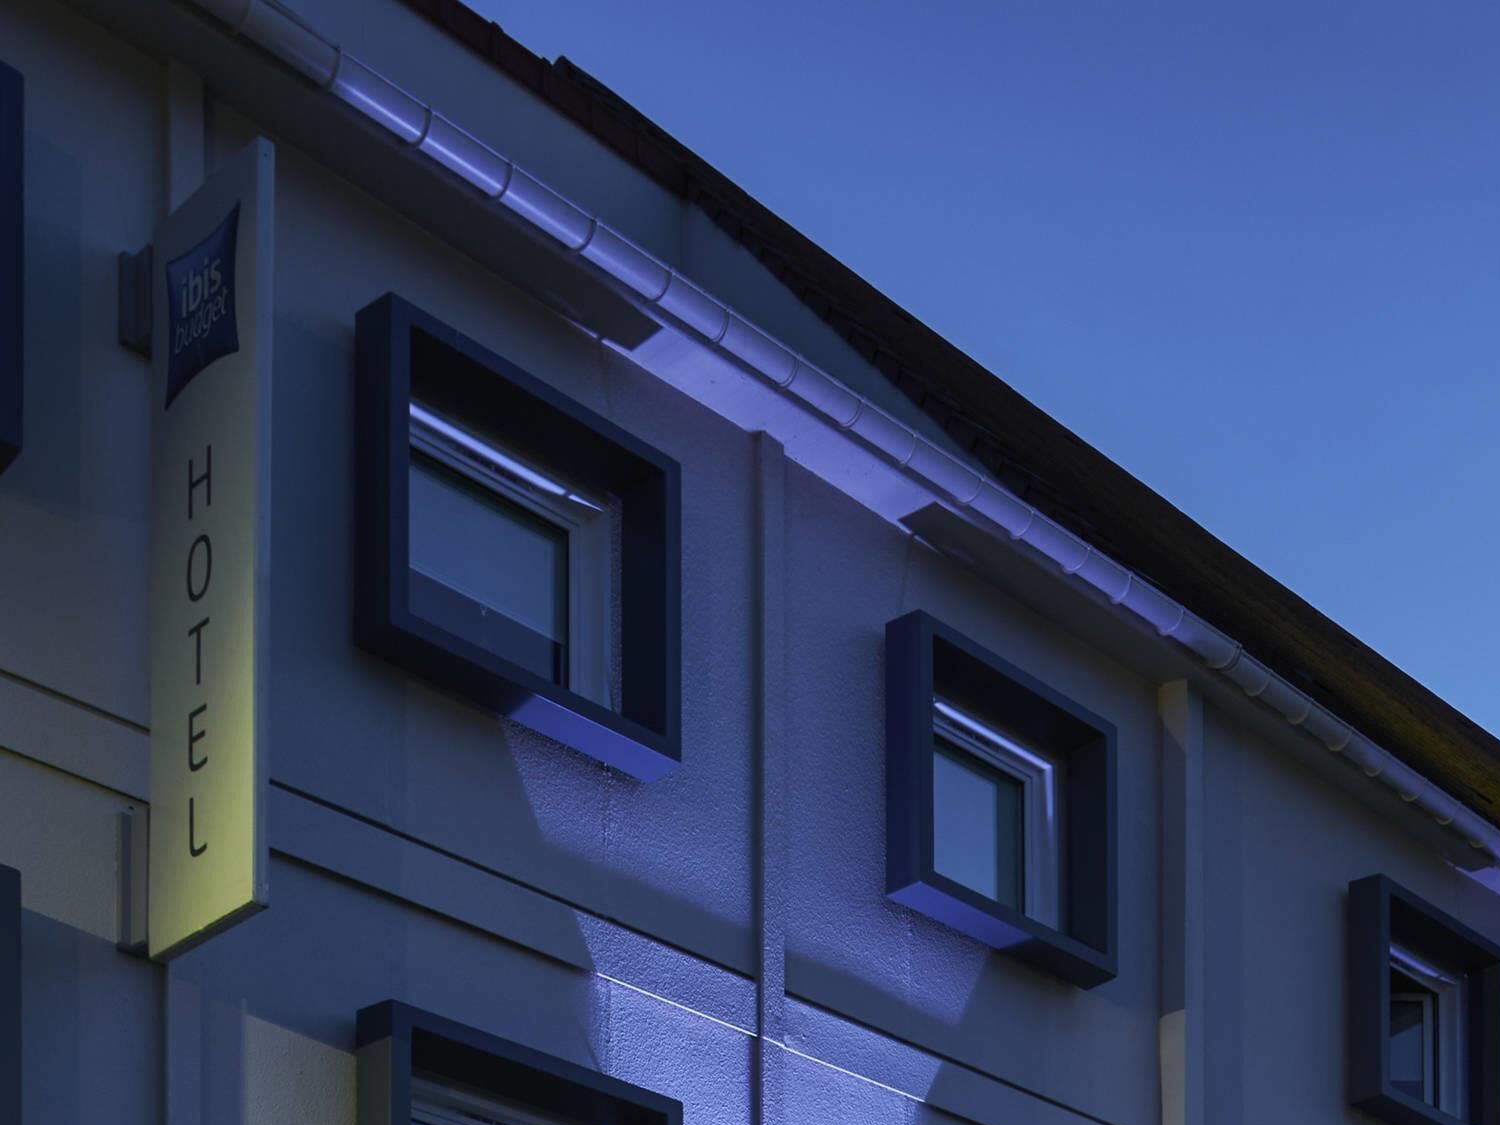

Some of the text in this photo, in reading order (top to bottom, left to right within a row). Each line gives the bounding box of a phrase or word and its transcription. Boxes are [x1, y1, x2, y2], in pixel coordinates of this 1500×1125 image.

[175, 285, 229, 354] budget
[181, 256, 222, 319] ibis
[187, 443, 212, 858] HOTEL
